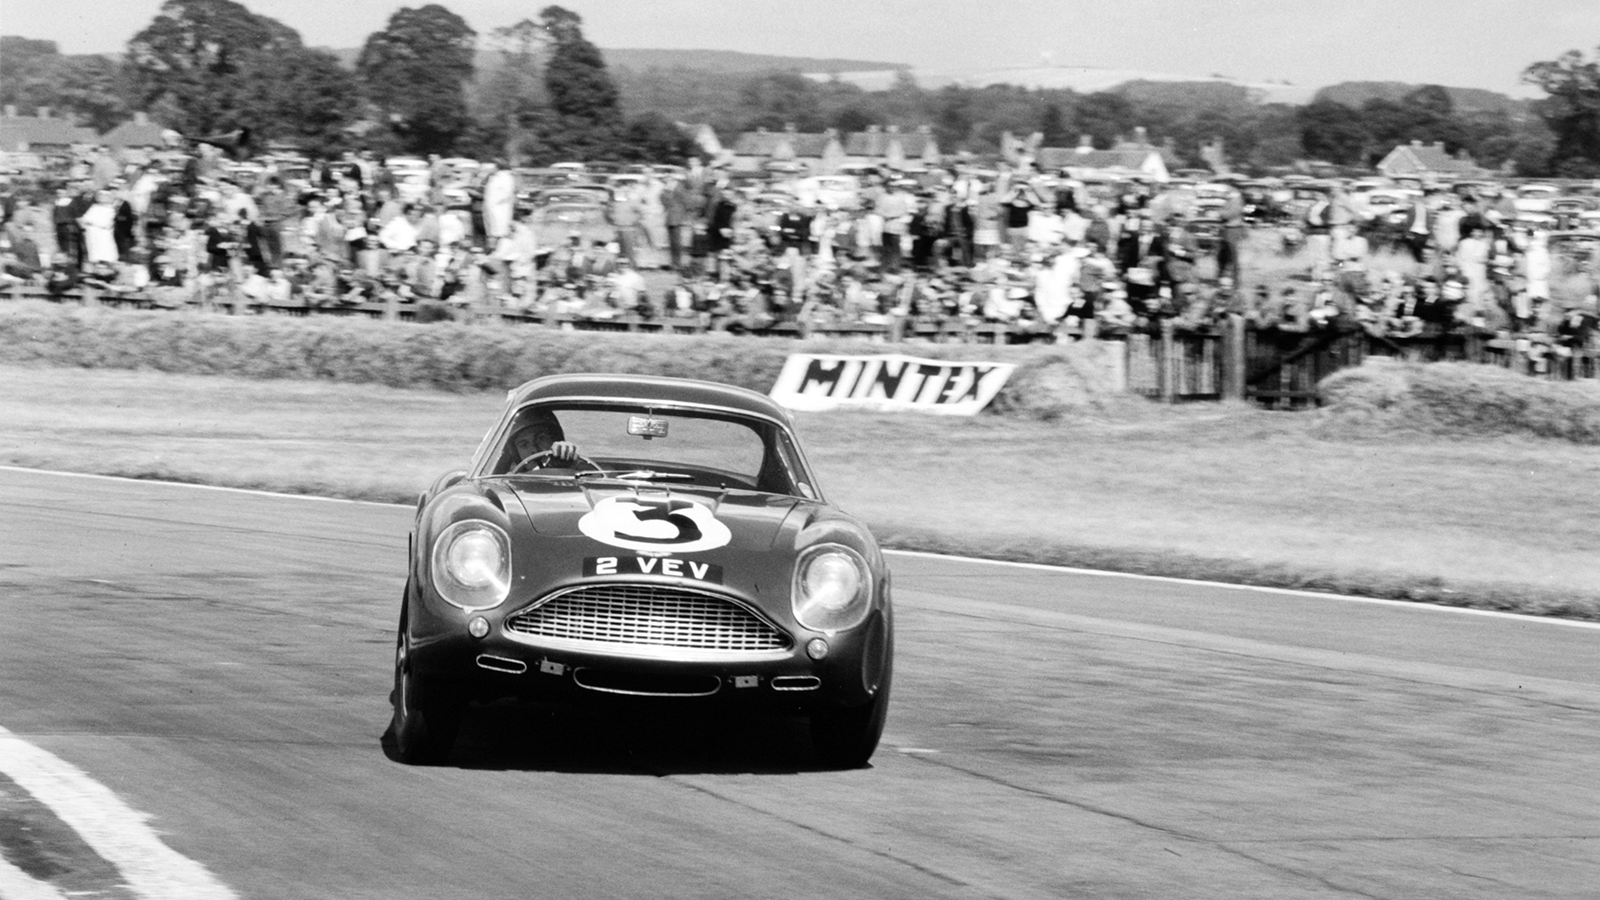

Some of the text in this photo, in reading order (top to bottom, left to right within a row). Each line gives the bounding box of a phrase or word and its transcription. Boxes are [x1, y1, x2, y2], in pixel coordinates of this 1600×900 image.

[797, 358, 1000, 405] MINTEX
[614, 497, 703, 544] 3
[596, 556, 709, 580] 2 VEV
